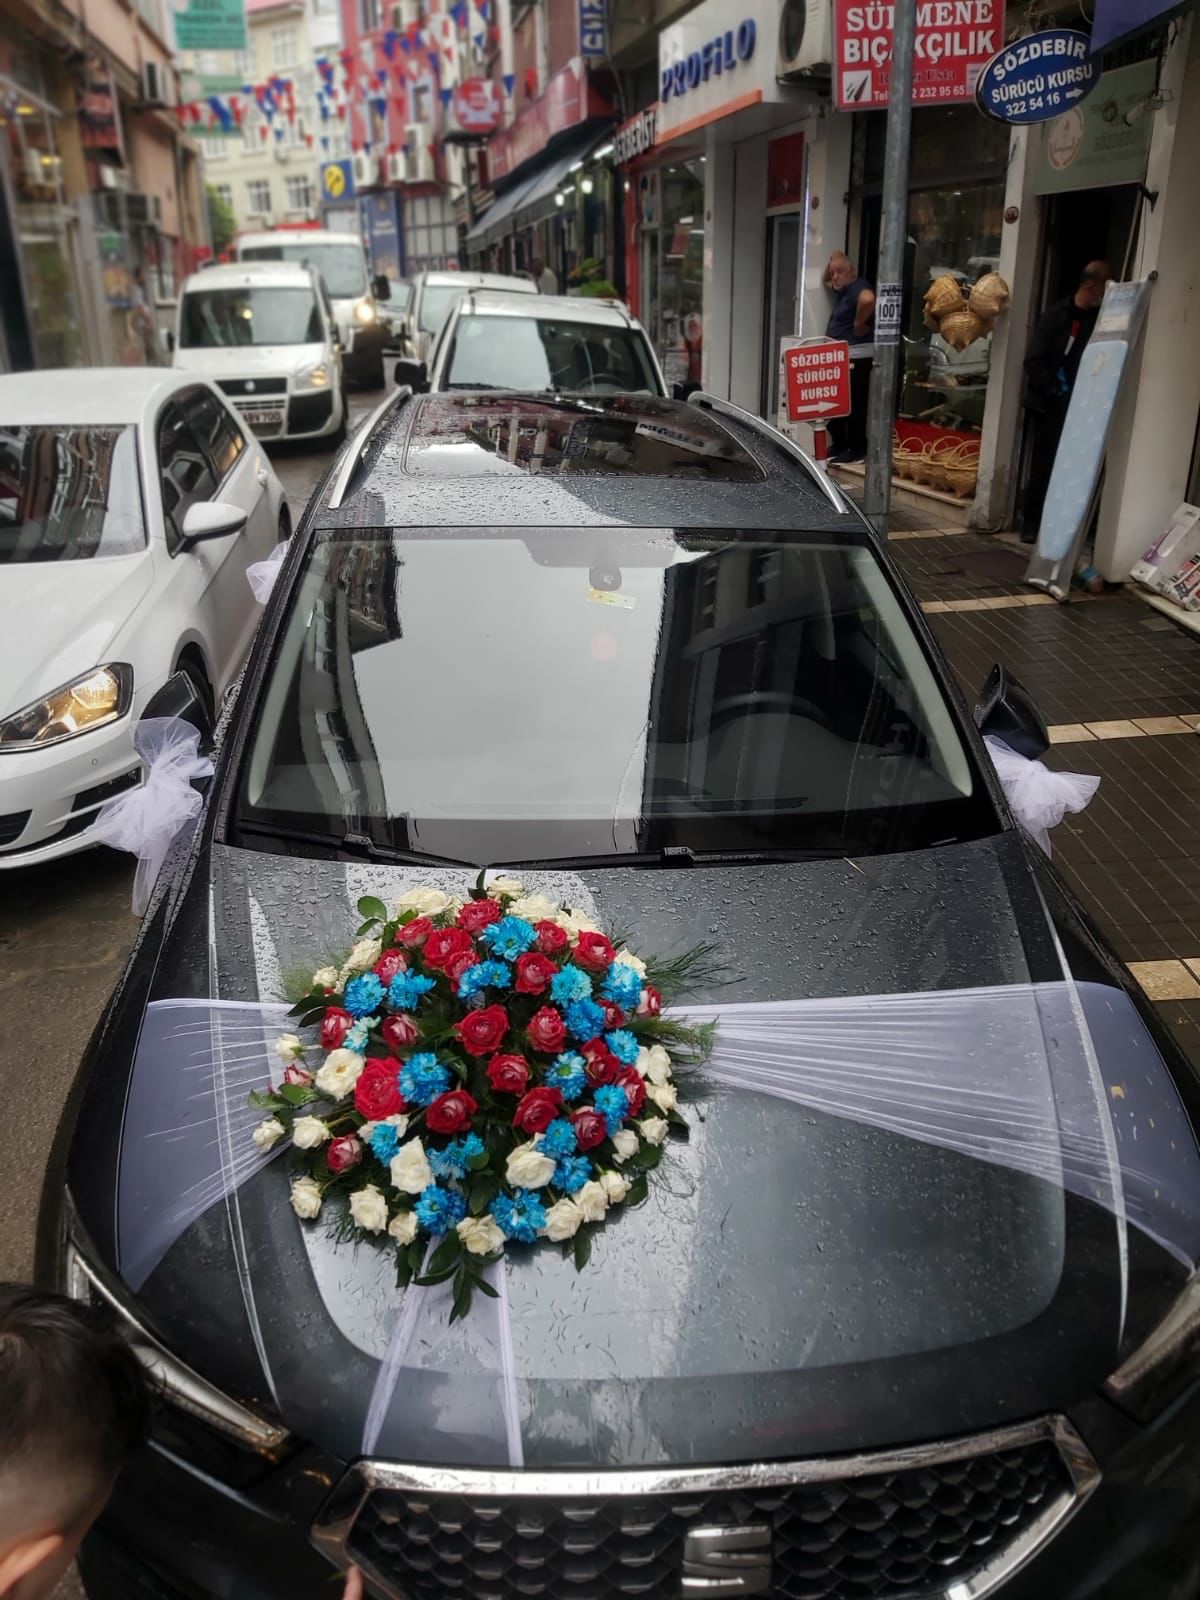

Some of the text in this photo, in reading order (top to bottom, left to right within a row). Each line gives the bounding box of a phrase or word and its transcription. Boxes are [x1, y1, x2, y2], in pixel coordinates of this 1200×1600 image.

[847, 0, 994, 32] SÜMENE
[843, 30, 995, 67] BIÇKÇILIK
[993, 36, 1087, 81] SÖZDEBİR
[919, 87, 938, 98] 232
[939, 85, 952, 97] 95
[953, 84, 966, 96] 65
[991, 75, 1045, 103] SÜRÜCÜ
[1048, 63, 1093, 90] KURSU
[1005, 91, 1061, 117] 322 54 16
[791, 348, 846, 369] SÖZDEBİR
[796, 366, 841, 385] SÜRÜCÜ
[800, 385, 838, 401] KURSU
